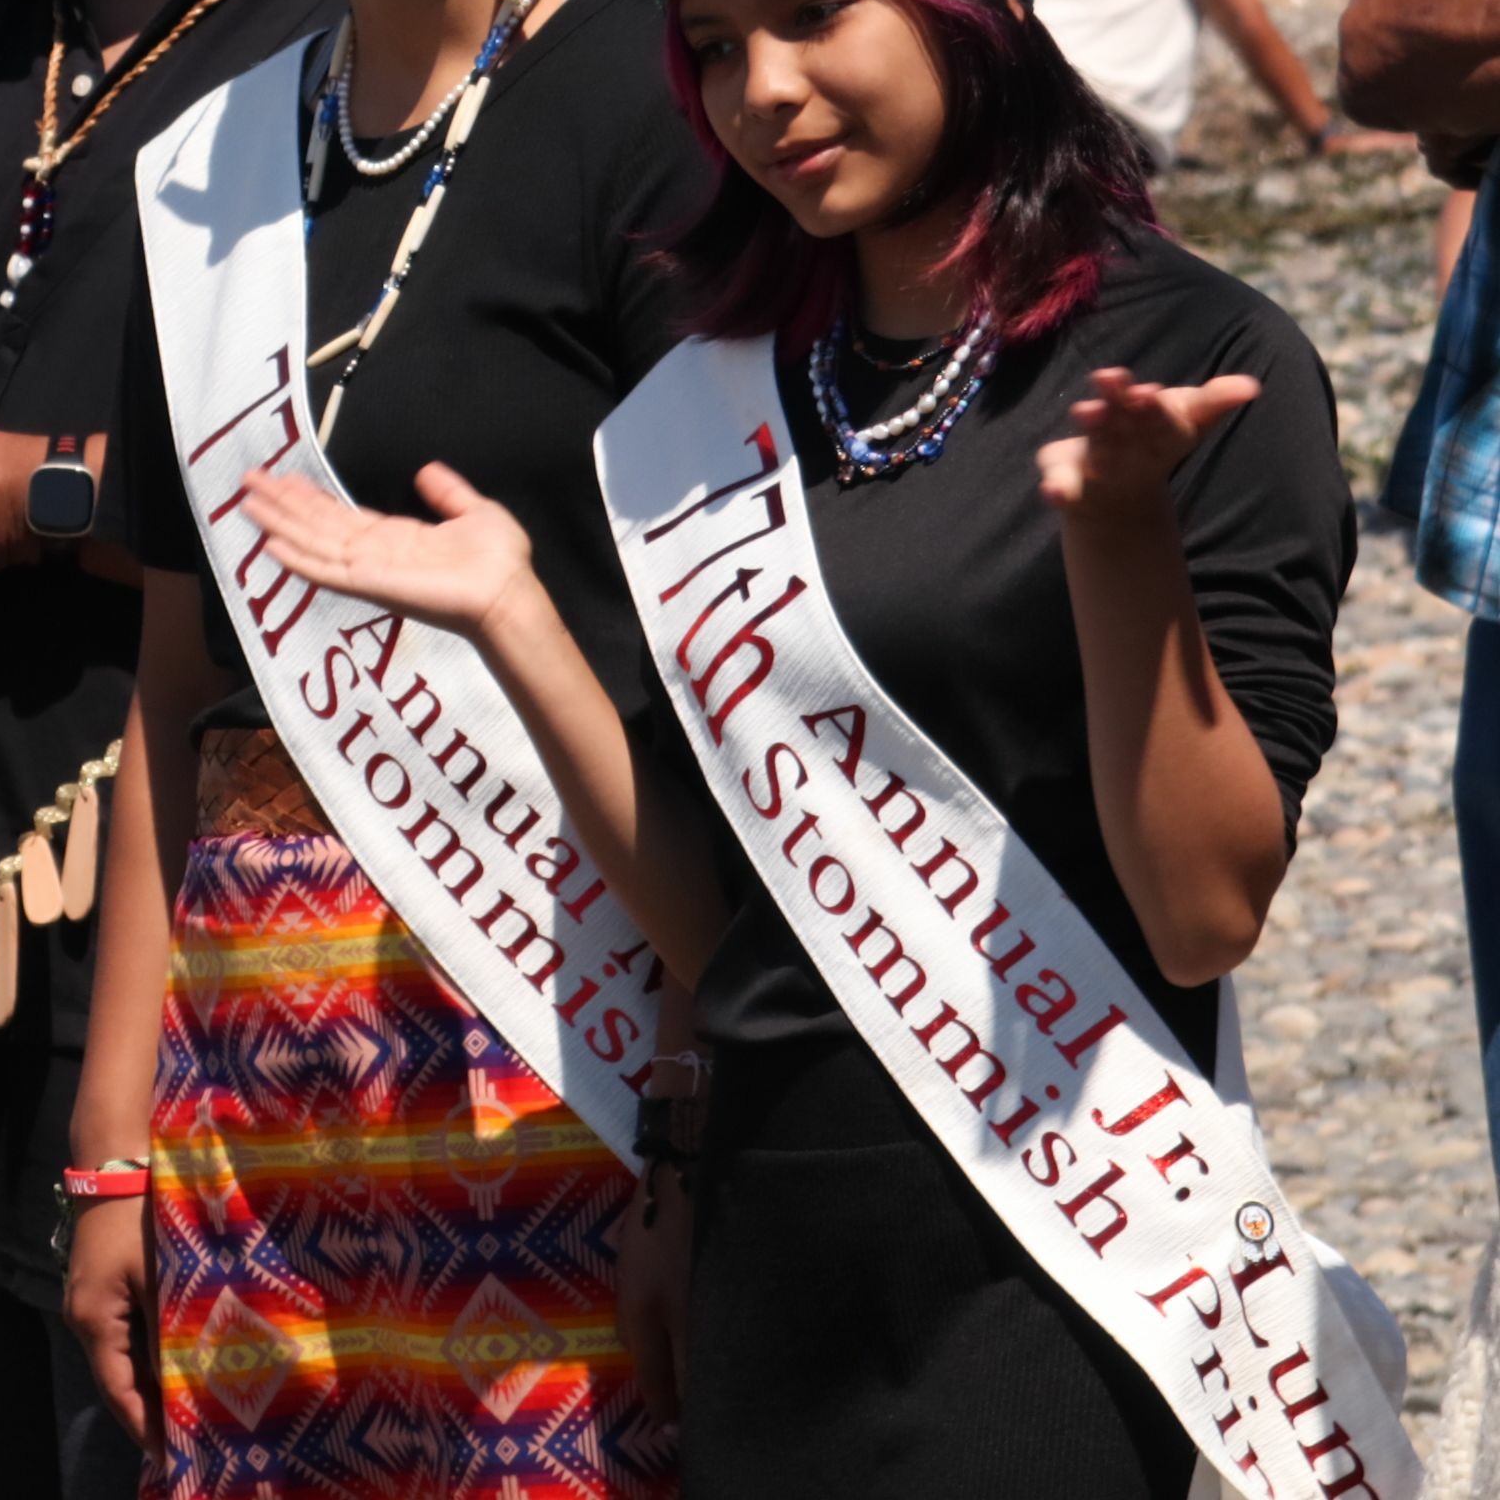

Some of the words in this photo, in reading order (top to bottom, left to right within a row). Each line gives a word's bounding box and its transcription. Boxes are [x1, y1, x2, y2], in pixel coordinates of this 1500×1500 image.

[340, 610, 606, 925] Annual
[642, 422, 808, 747] 77th
[799, 702, 1129, 1070] Annual
[1090, 1069, 1210, 1202] Jr.
[741, 741, 1129, 1260] Stommish
